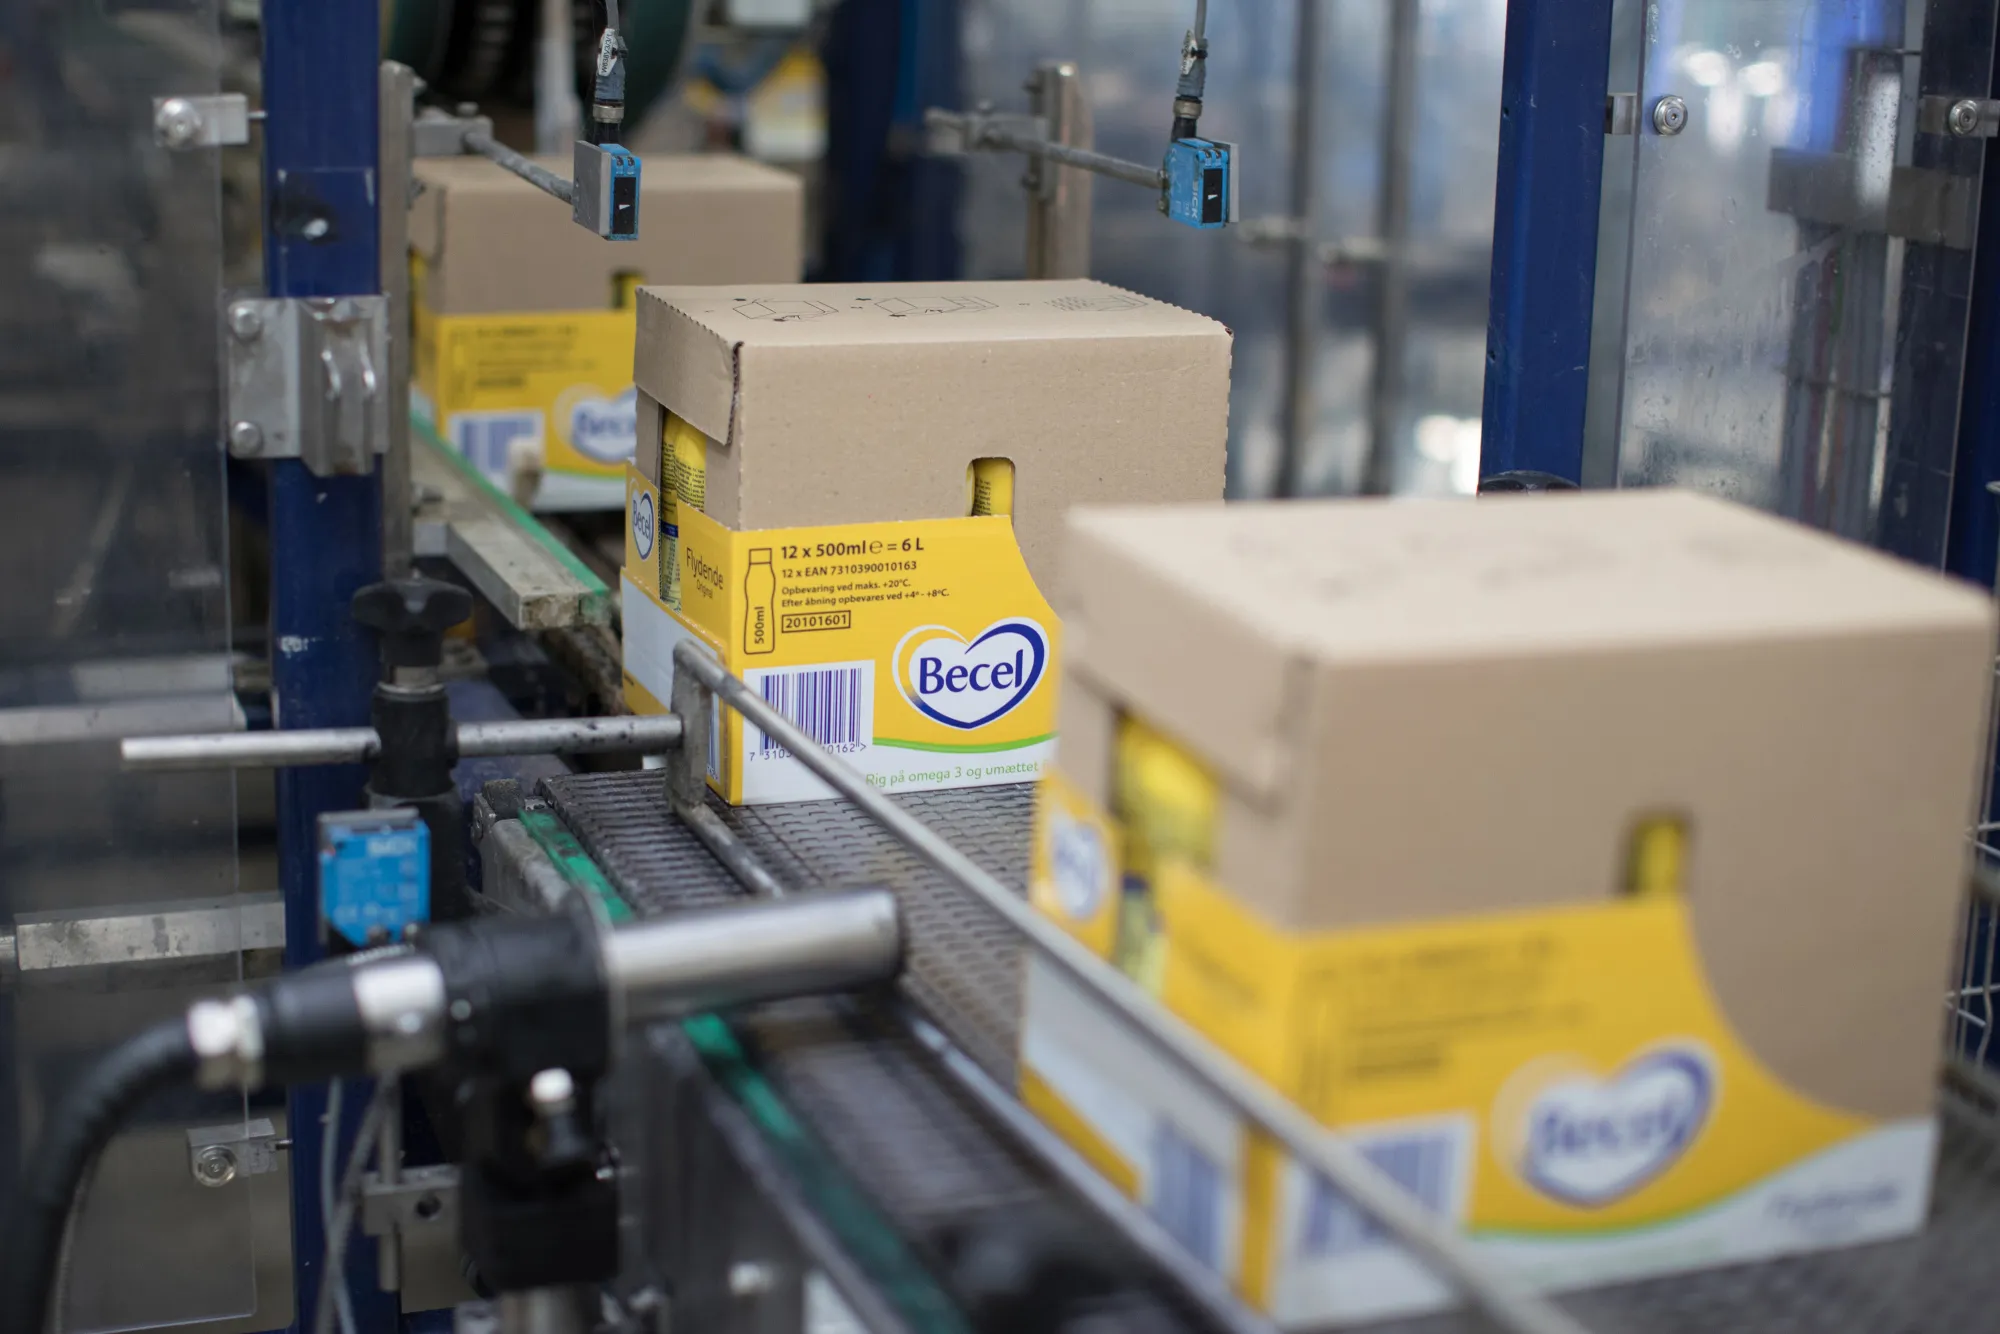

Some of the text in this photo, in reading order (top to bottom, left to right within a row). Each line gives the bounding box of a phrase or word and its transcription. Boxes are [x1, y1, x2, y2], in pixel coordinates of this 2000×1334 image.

[632, 499, 652, 542] Becel
[781, 545, 798, 559] 12
[803, 547, 811, 558] x
[816, 540, 866, 557] 500ml
[887, 543, 897, 551] =
[902, 538, 911, 552] 6
[916, 537, 924, 551] L
[686, 546, 724, 591] Flydende
[782, 561, 917, 578] 12 x EAN 7310390010163
[782, 584, 835, 596] Opbevaring
[837, 582, 853, 591] ved
[855, 581, 881, 590] maks.
[782, 598, 804, 608] Efter
[805, 597, 837, 606] åbning
[838, 594, 884, 605] opbevares
[886, 591, 902, 600] ved
[754, 606, 764, 644] 500ml
[786, 614, 847, 629] 20101601
[919, 649, 1023, 694] Becel
[866, 774, 886, 788] Rig
[890, 770, 905, 786] på
[908, 768, 950, 783] omega
[955, 767, 962, 778] 3
[966, 767, 982, 780] og
[986, 762, 1039, 776] umættet
